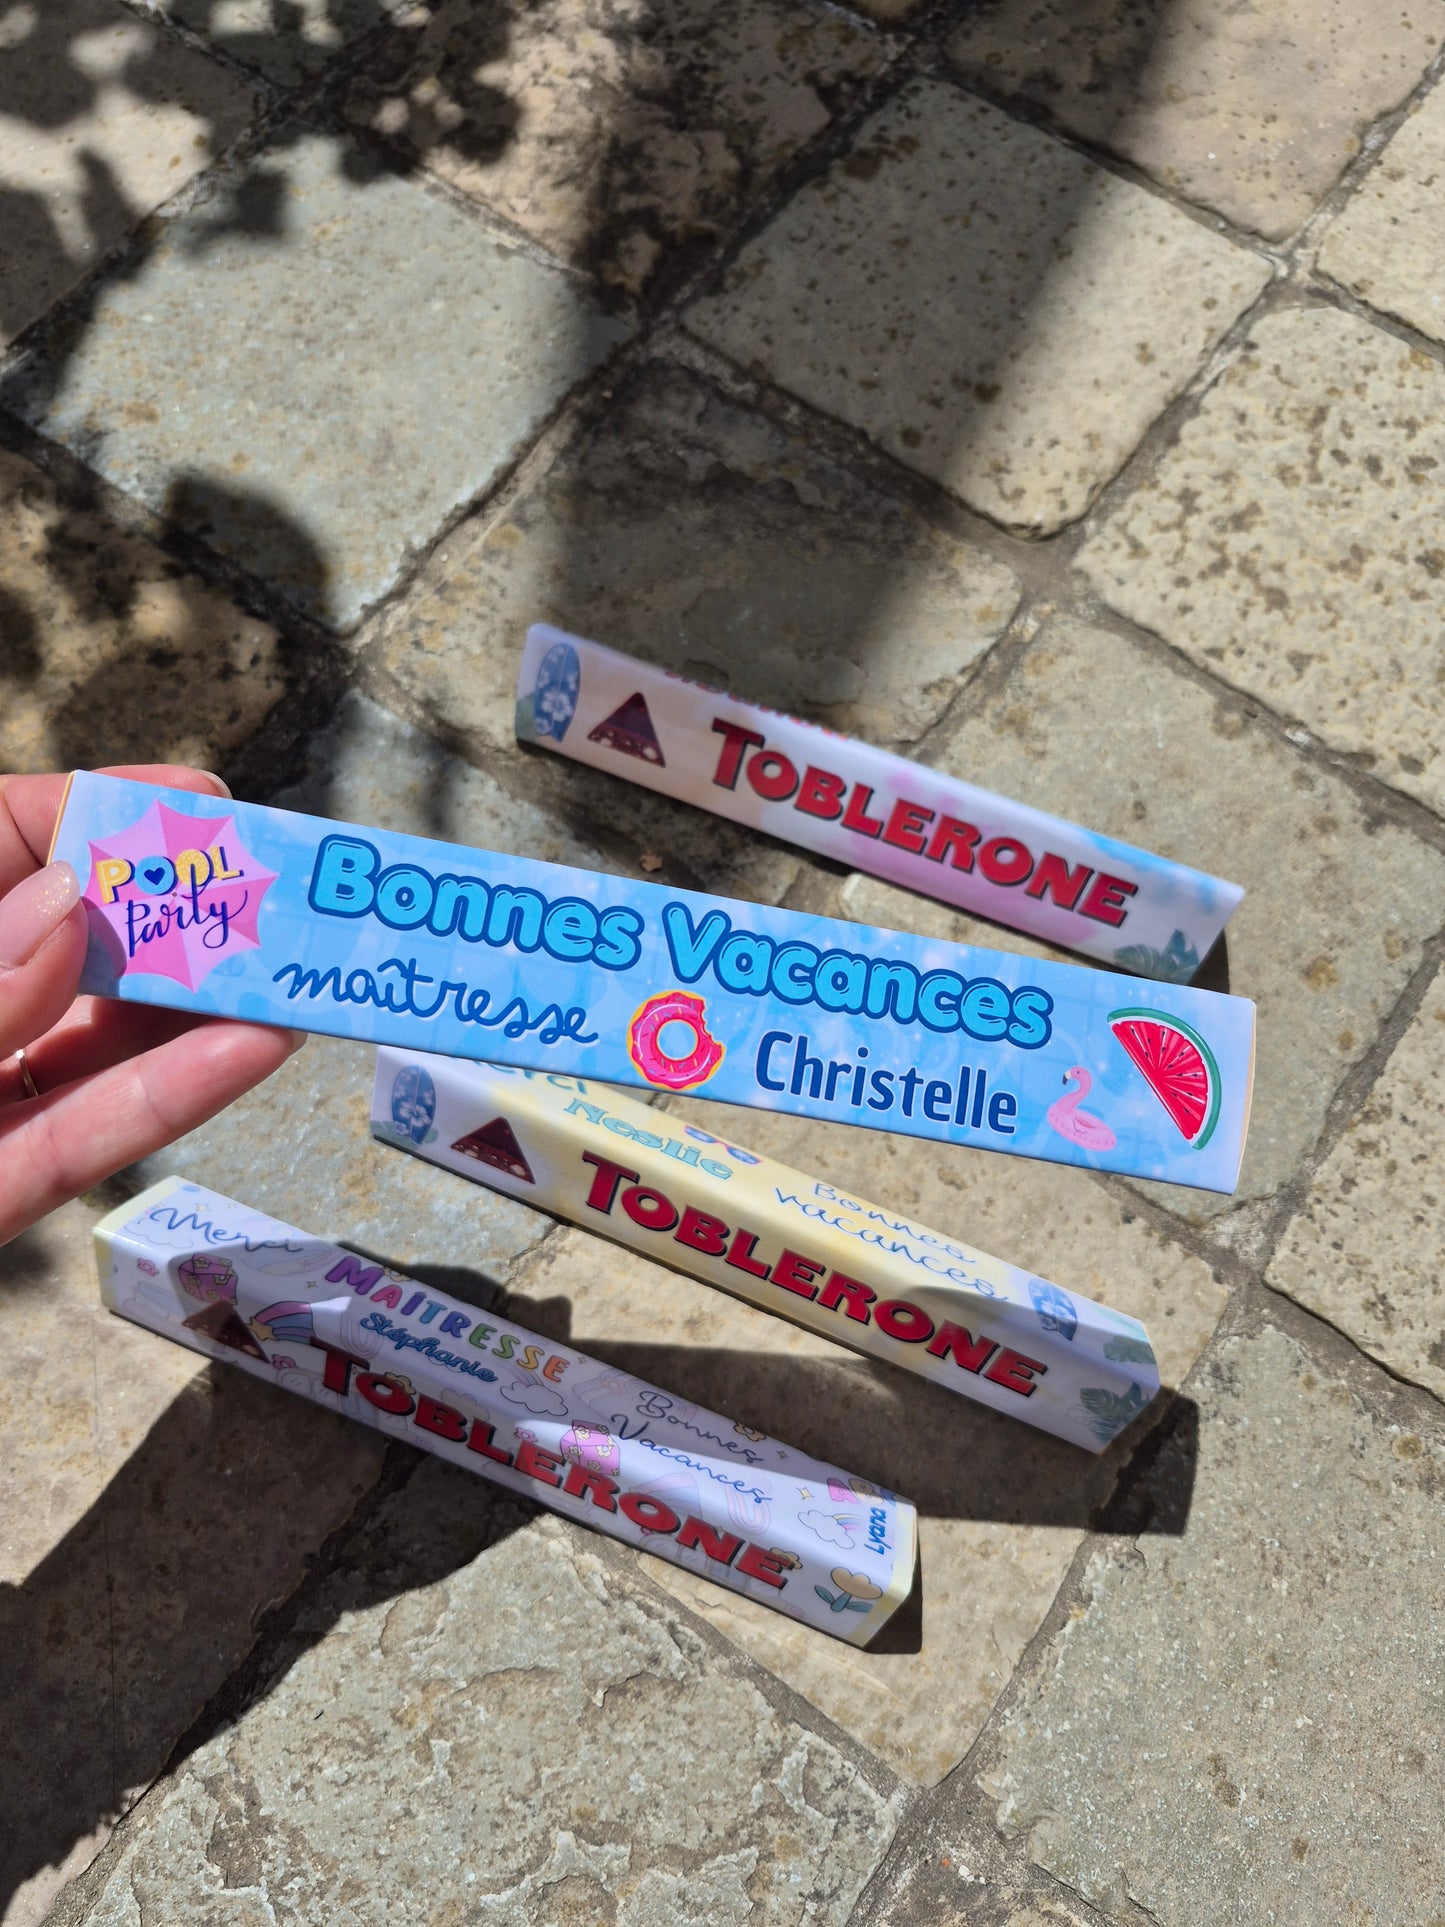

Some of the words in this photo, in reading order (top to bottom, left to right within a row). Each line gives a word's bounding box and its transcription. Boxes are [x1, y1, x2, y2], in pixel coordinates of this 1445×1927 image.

[711, 717, 1138, 928] TOBLERONE
[96, 846, 244, 903] POOL
[125, 863, 247, 958] Party
[308, 833, 644, 971] Bonnes
[662, 901, 1054, 1050] Vacances
[272, 958, 598, 1045] maîtresse
[755, 1031, 1018, 1134] Christelle
[564, 1098, 733, 1180] Neslie
[150, 1208, 304, 1252] Merci
[814, 1183, 975, 1263] Bonnes
[582, 1150, 1047, 1397] TOBLERONE
[360, 1312, 498, 1382] Stéphanie
[309, 1336, 788, 1589] TOBLERONE
[611, 1414, 772, 1503] Vacances
[636, 1391, 763, 1463] Bonnes
[864, 1507, 891, 1555] Lyana
